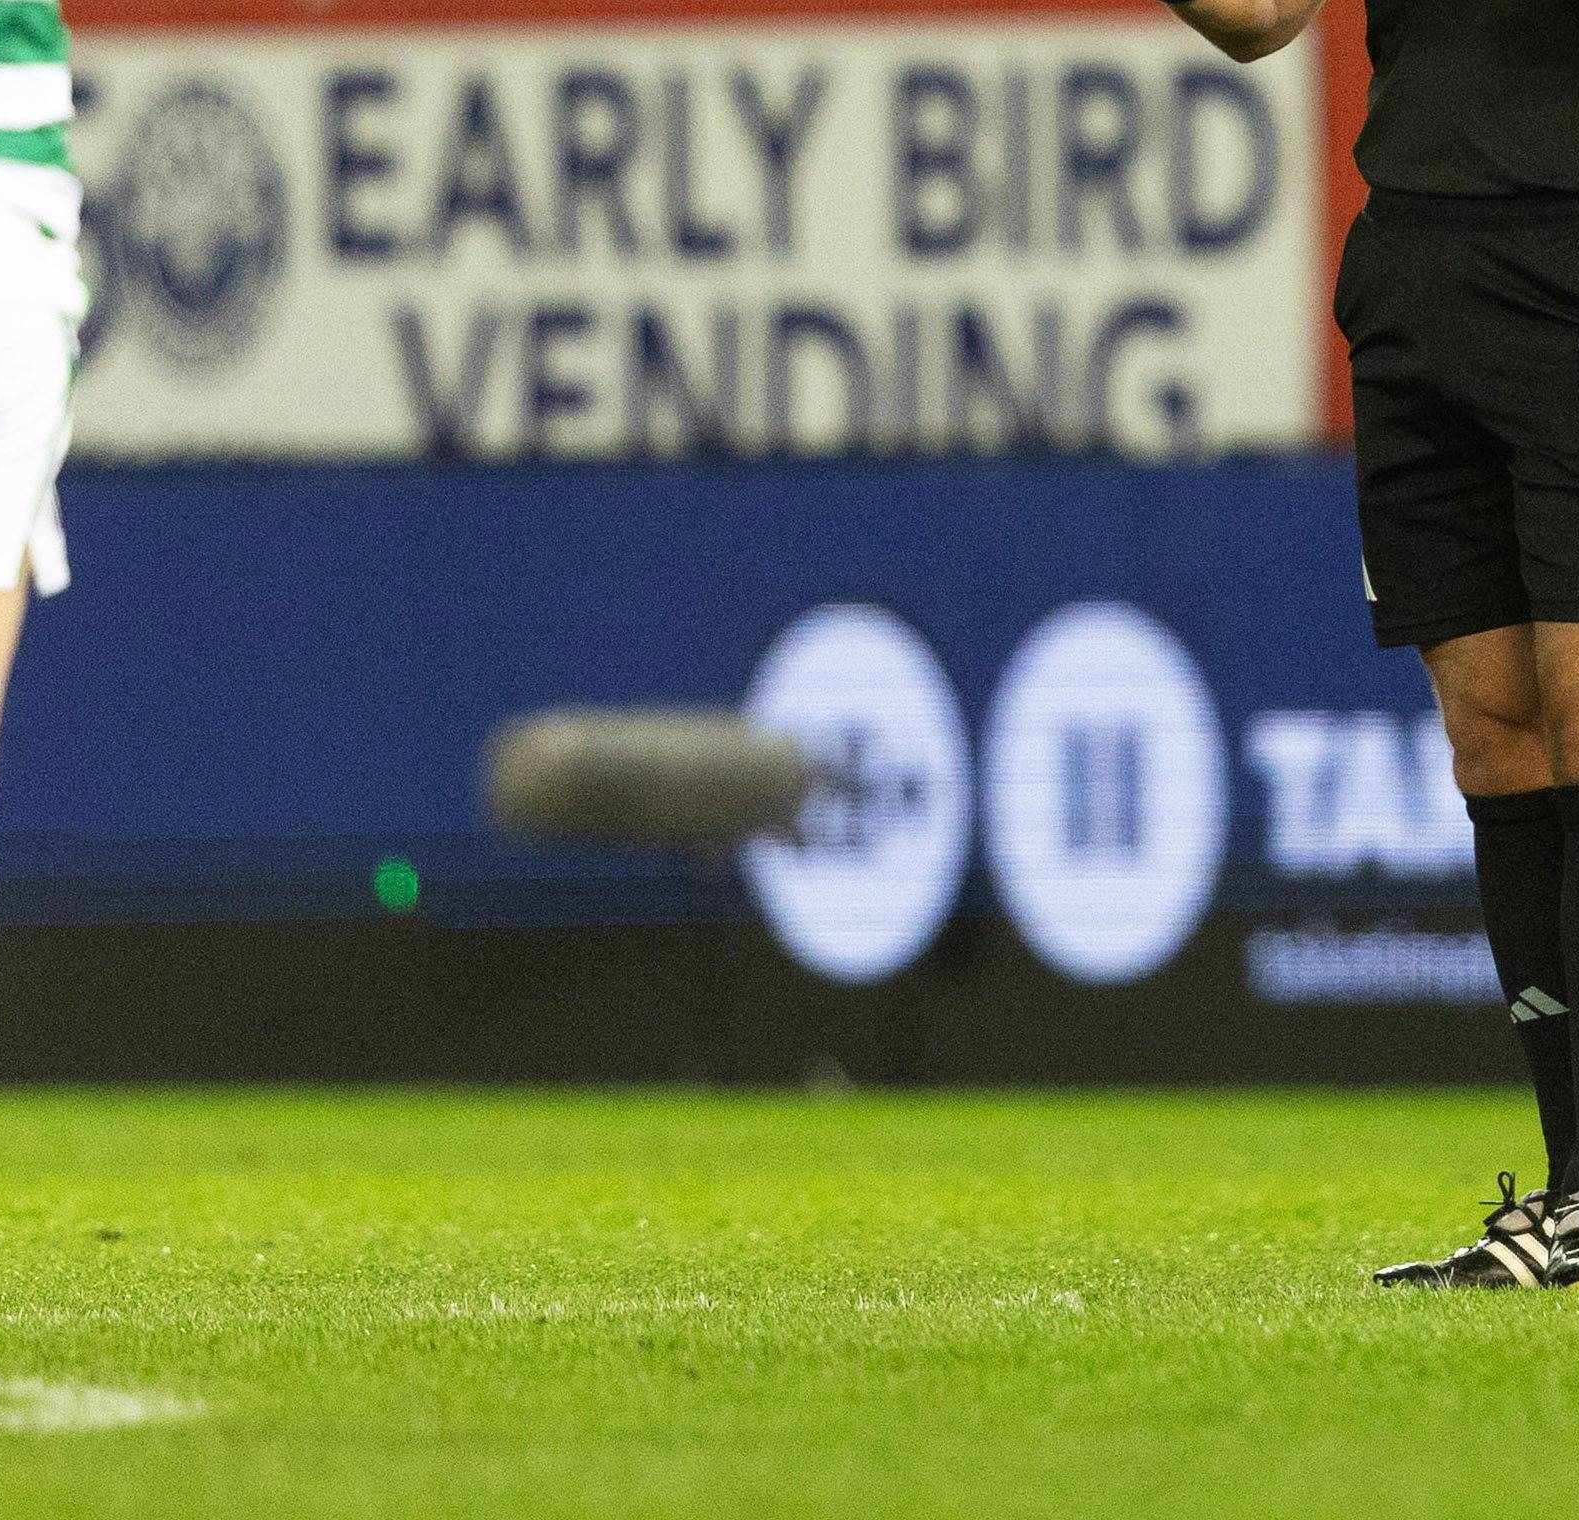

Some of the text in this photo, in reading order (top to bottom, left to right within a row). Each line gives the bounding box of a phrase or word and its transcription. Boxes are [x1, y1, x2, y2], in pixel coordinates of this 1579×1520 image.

[322, 62, 824, 262] EARLY
[892, 62, 1284, 262] BIRD
[394, 295, 1203, 462] VENDING
